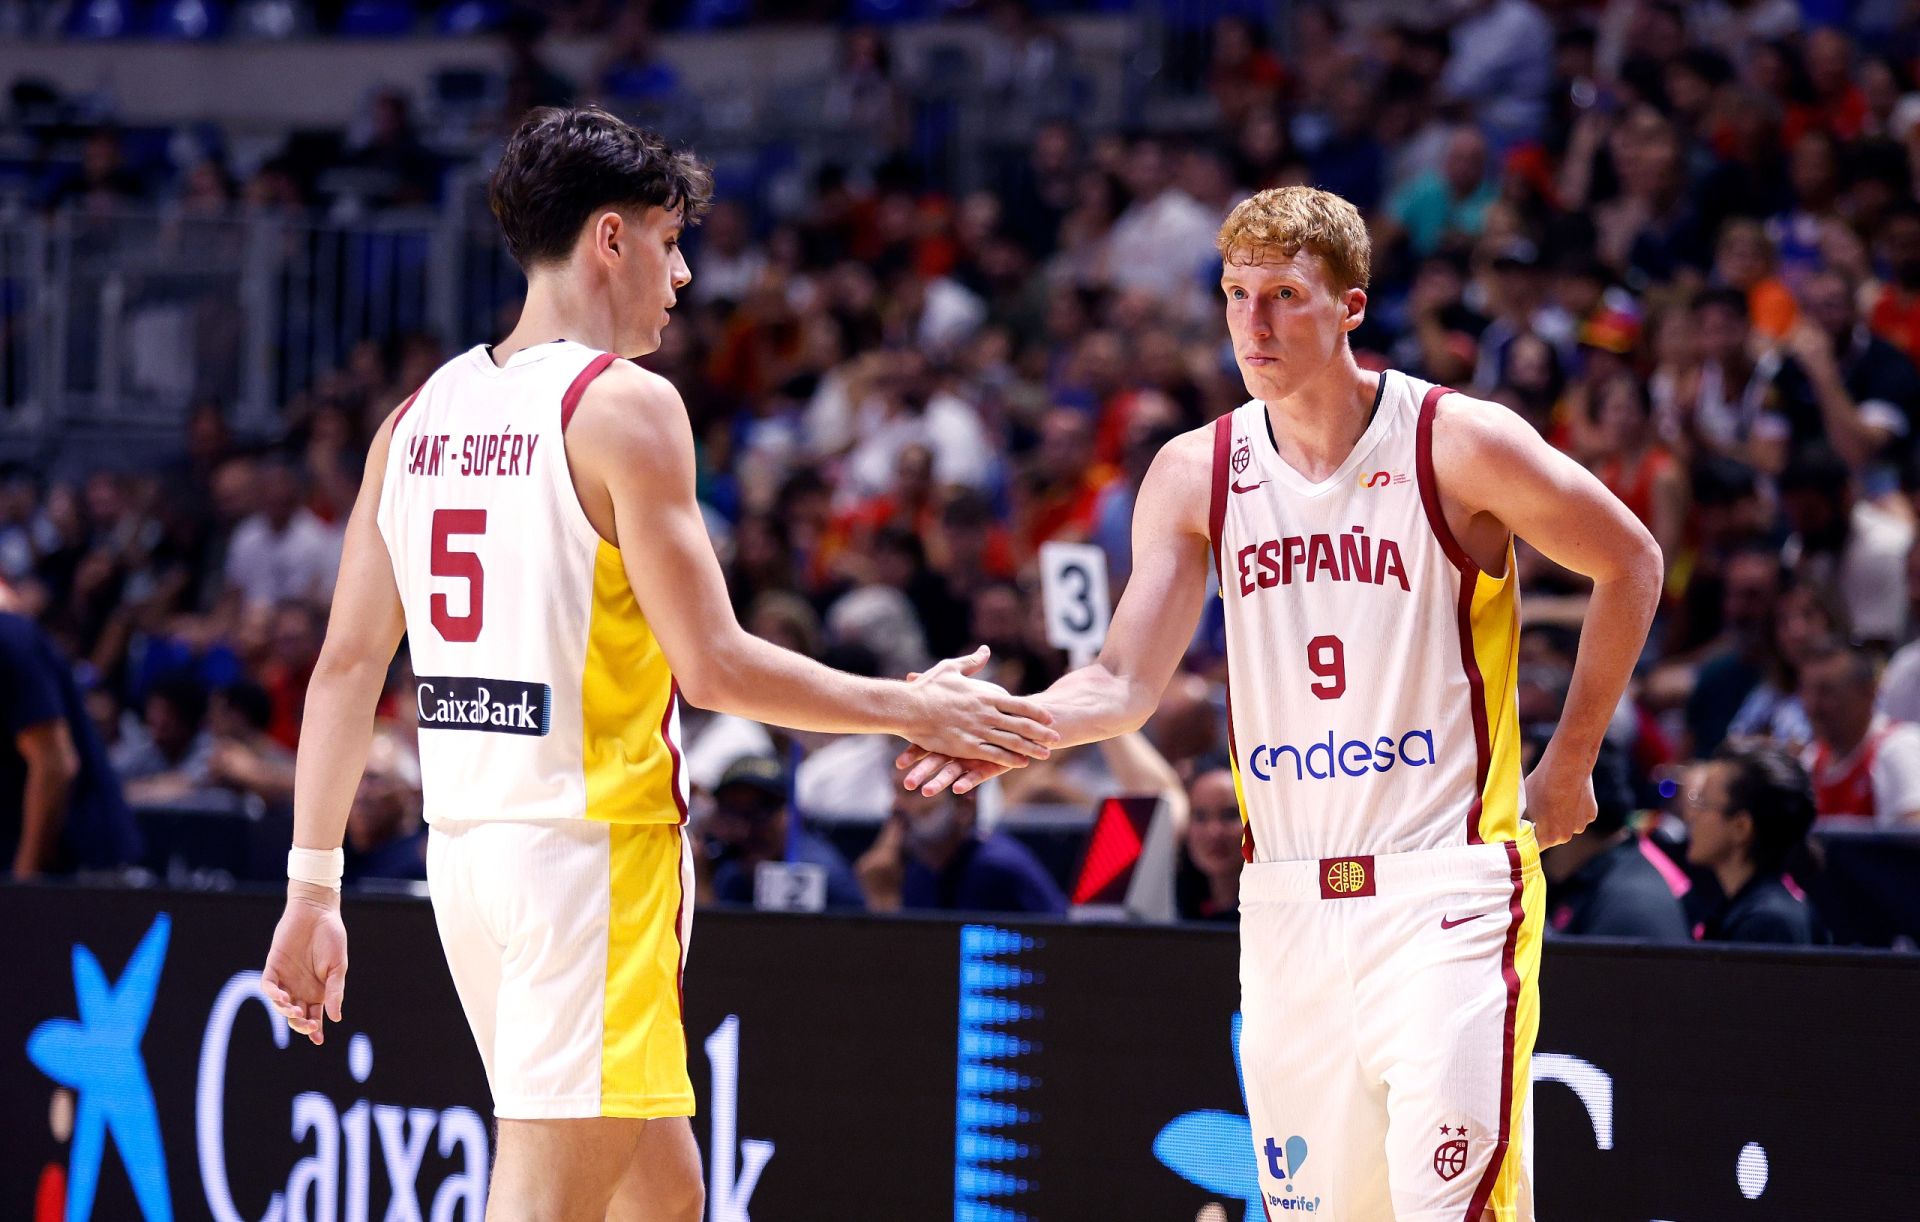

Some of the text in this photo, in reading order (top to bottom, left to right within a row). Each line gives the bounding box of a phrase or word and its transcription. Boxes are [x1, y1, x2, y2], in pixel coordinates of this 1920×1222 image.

[408, 424, 540, 477] ANT-SUPÉRY
[430, 509, 487, 642] 5
[1237, 525, 1411, 597] ESPAÑA
[1059, 565, 1094, 633] 3
[1307, 634, 1346, 700] 9
[417, 683, 538, 728] CaixaBank
[195, 969, 775, 1222] Caixak
